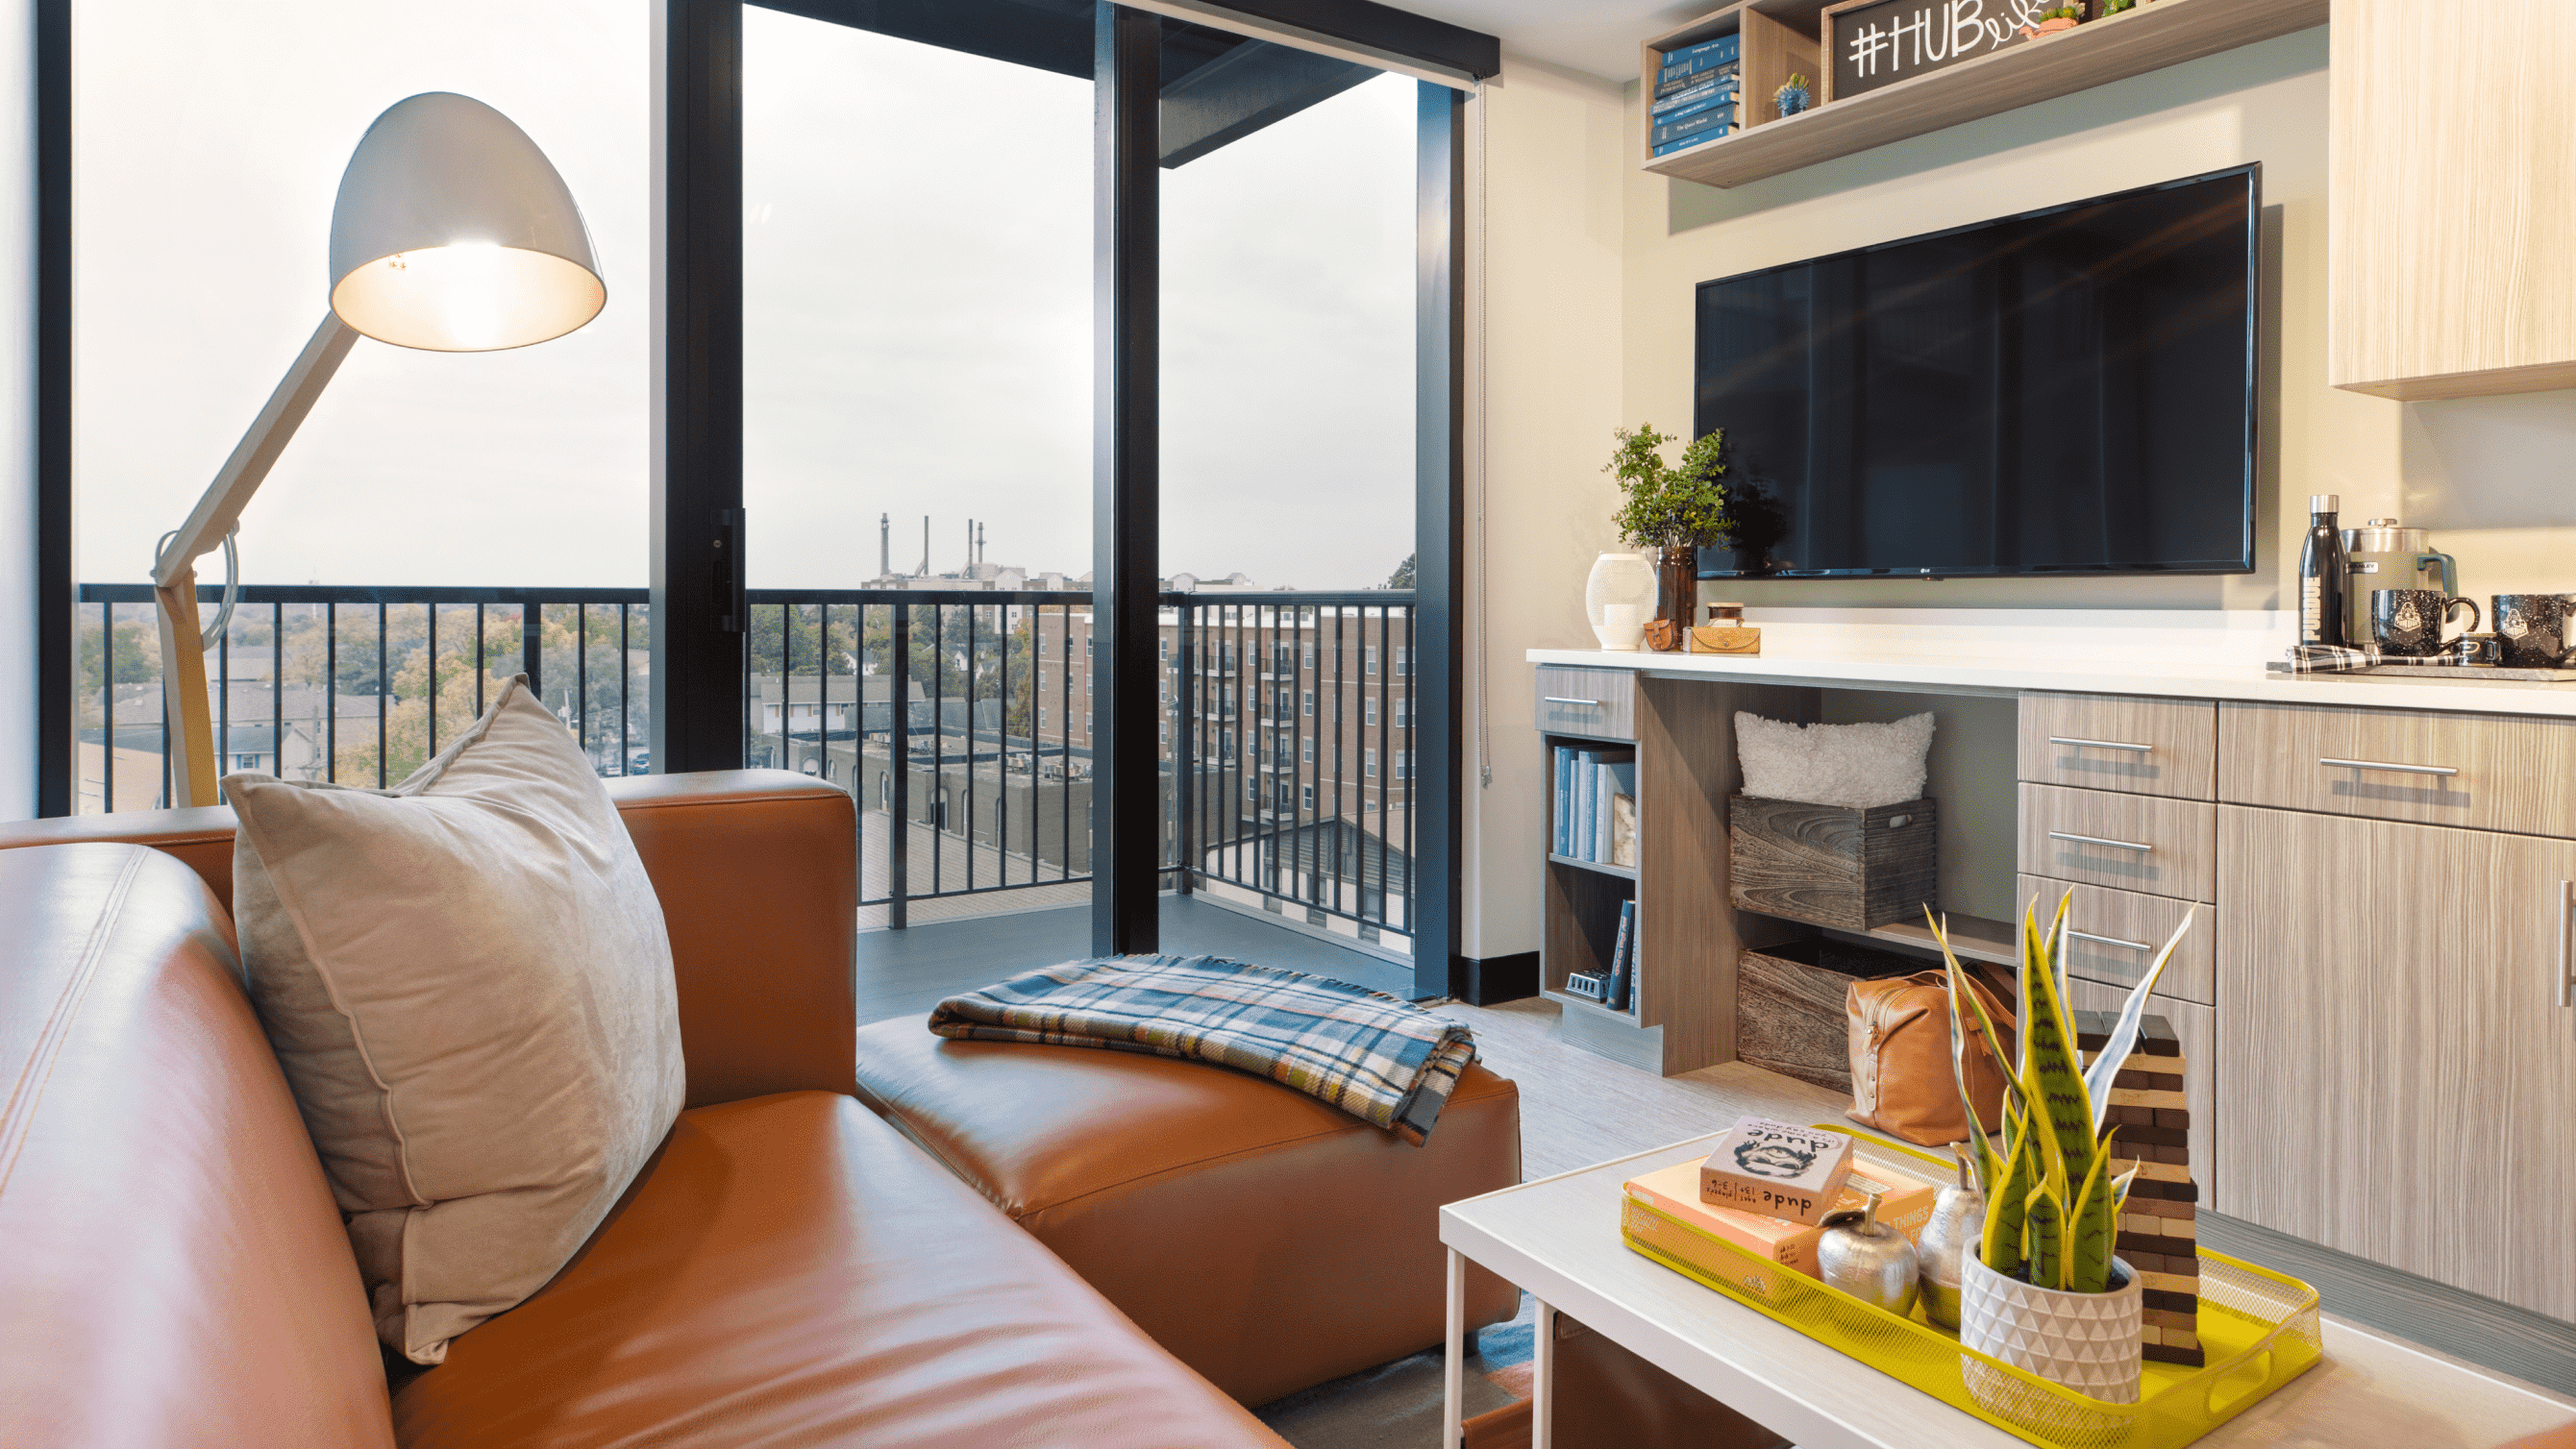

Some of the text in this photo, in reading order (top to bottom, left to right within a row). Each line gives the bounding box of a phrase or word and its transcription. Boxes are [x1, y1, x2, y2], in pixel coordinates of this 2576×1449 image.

[2303, 574, 2321, 642] PURDUE
[1746, 1128, 1830, 1153] dude
[1781, 1129, 1809, 1139] game
[1763, 1191, 1812, 1216] dude
[1893, 1206, 1929, 1229] THINGS
